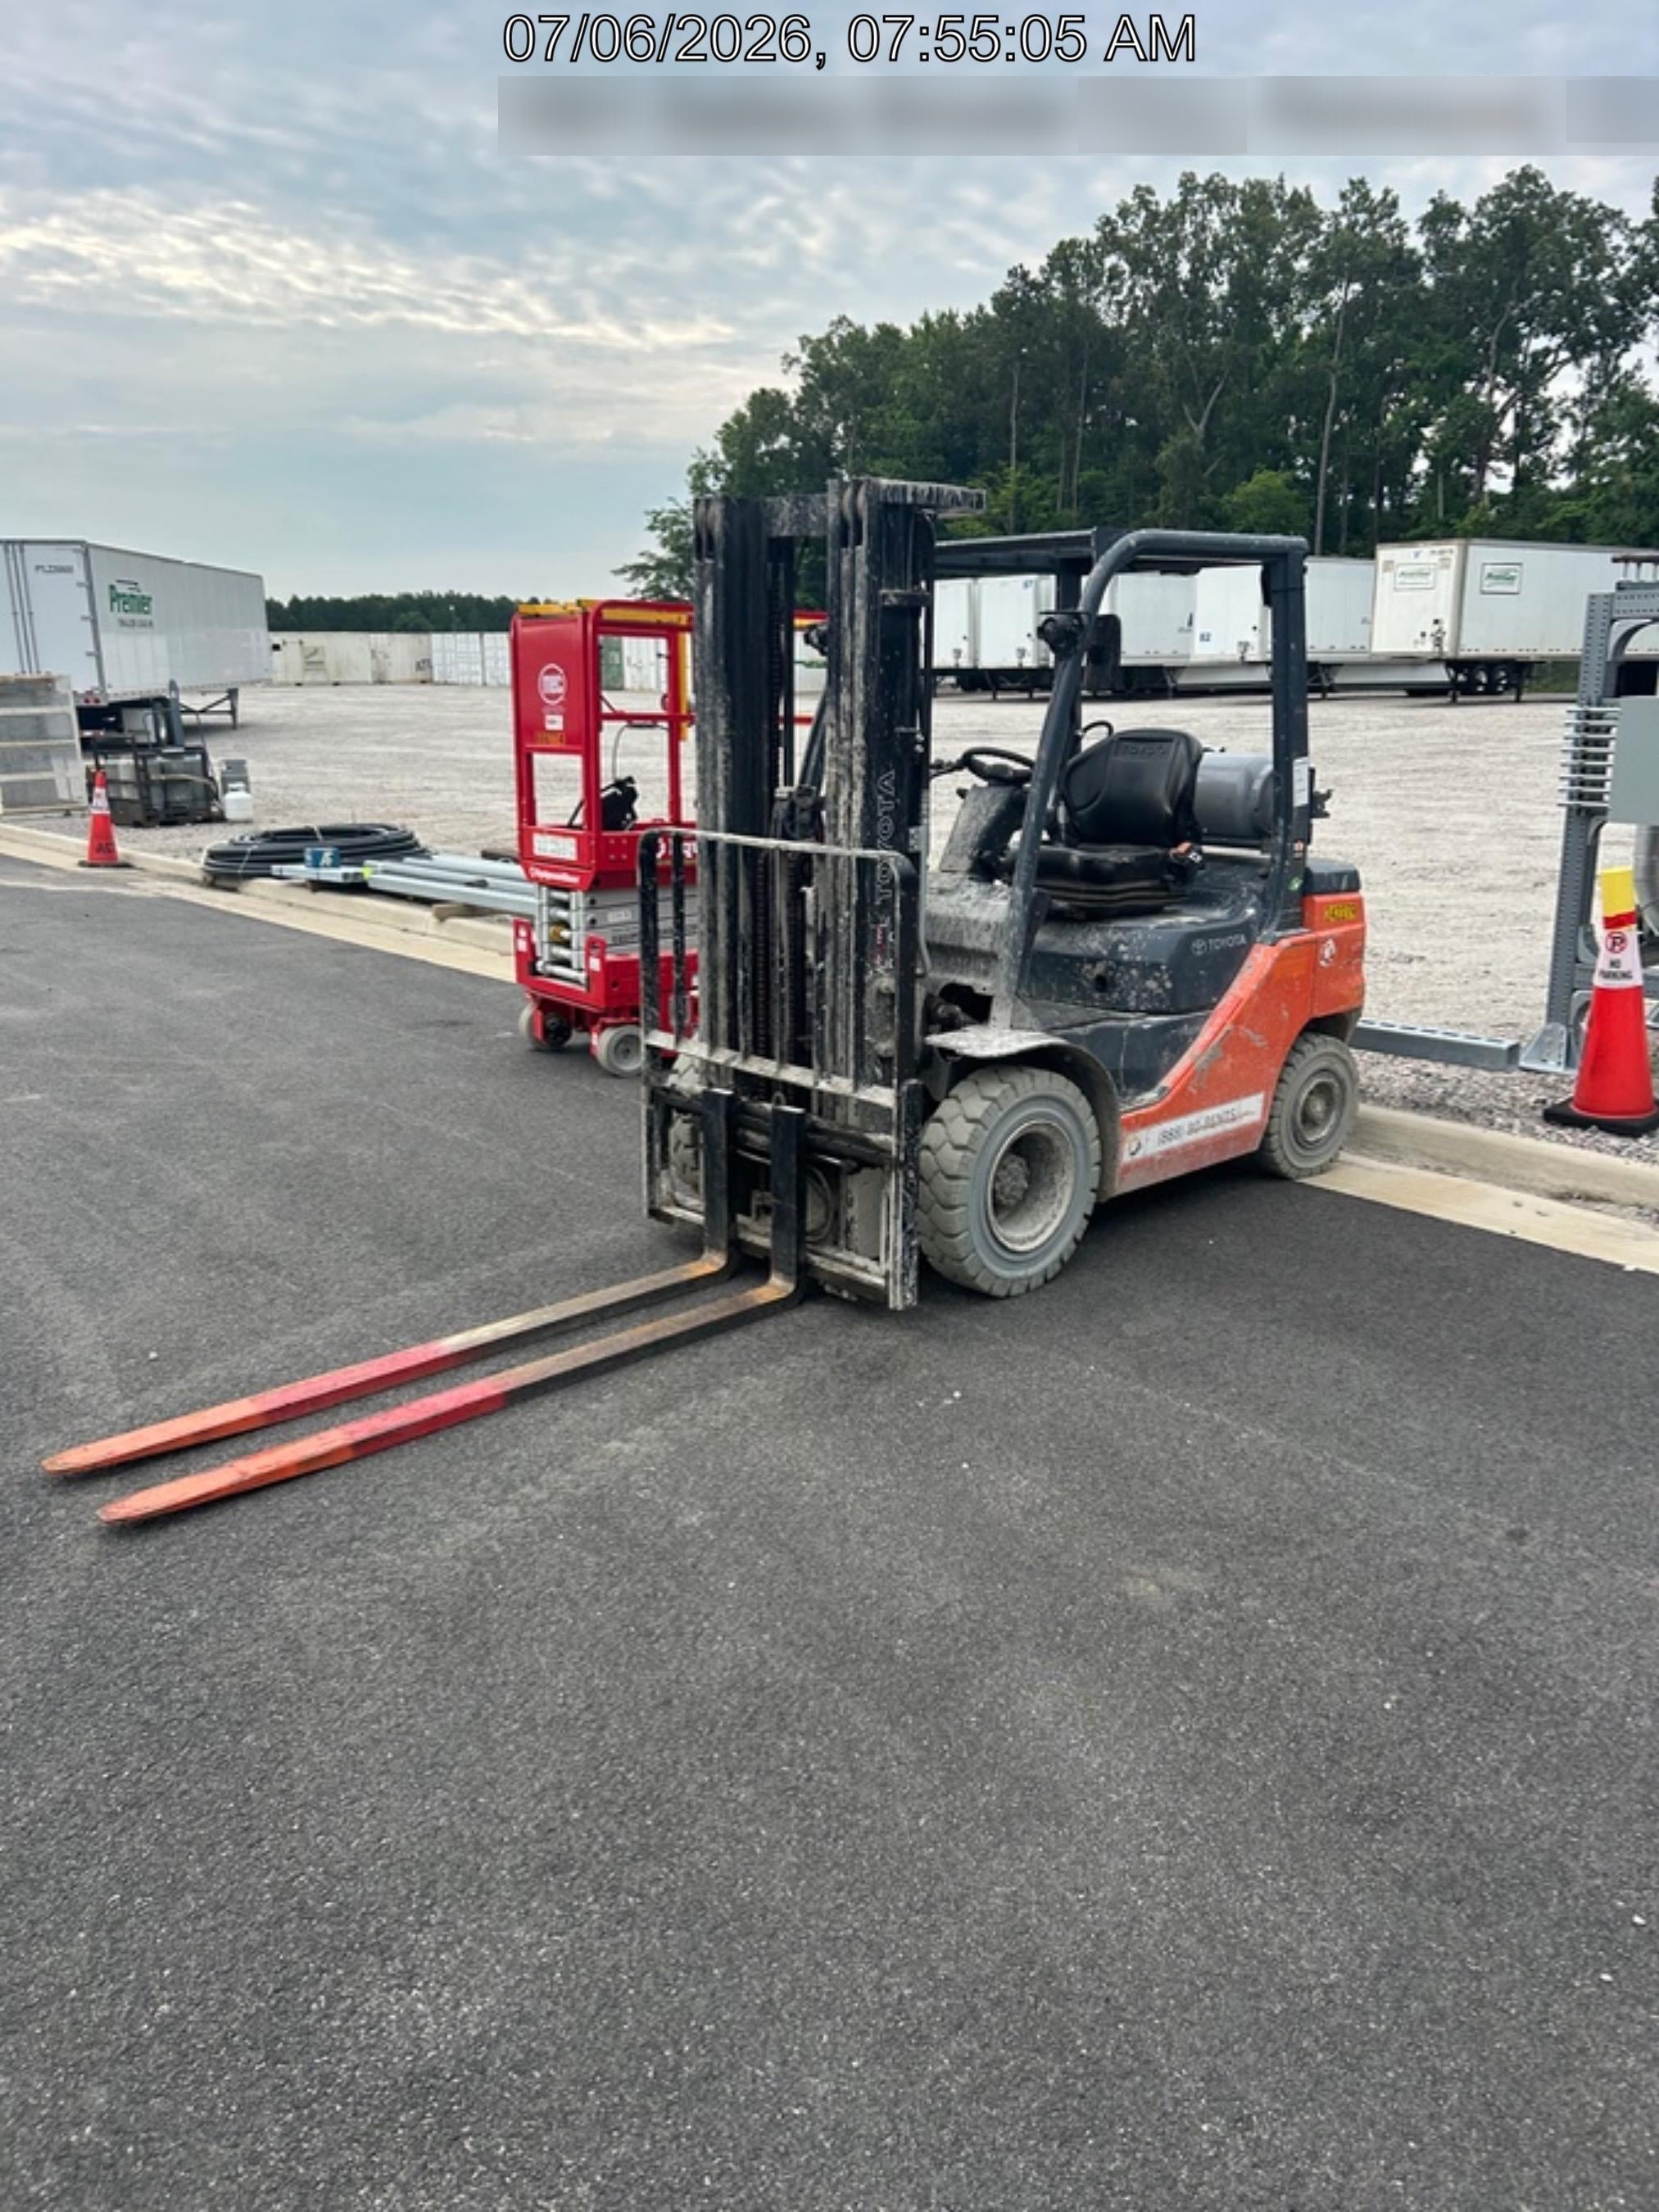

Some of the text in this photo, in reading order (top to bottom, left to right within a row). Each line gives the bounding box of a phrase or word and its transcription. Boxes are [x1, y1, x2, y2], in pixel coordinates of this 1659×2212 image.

[107, 584, 153, 616] Premier
[1208, 932, 1247, 952] TOYOTA
[1610, 959, 1620, 968] NO
[1599, 970, 1633, 980] PARKING
